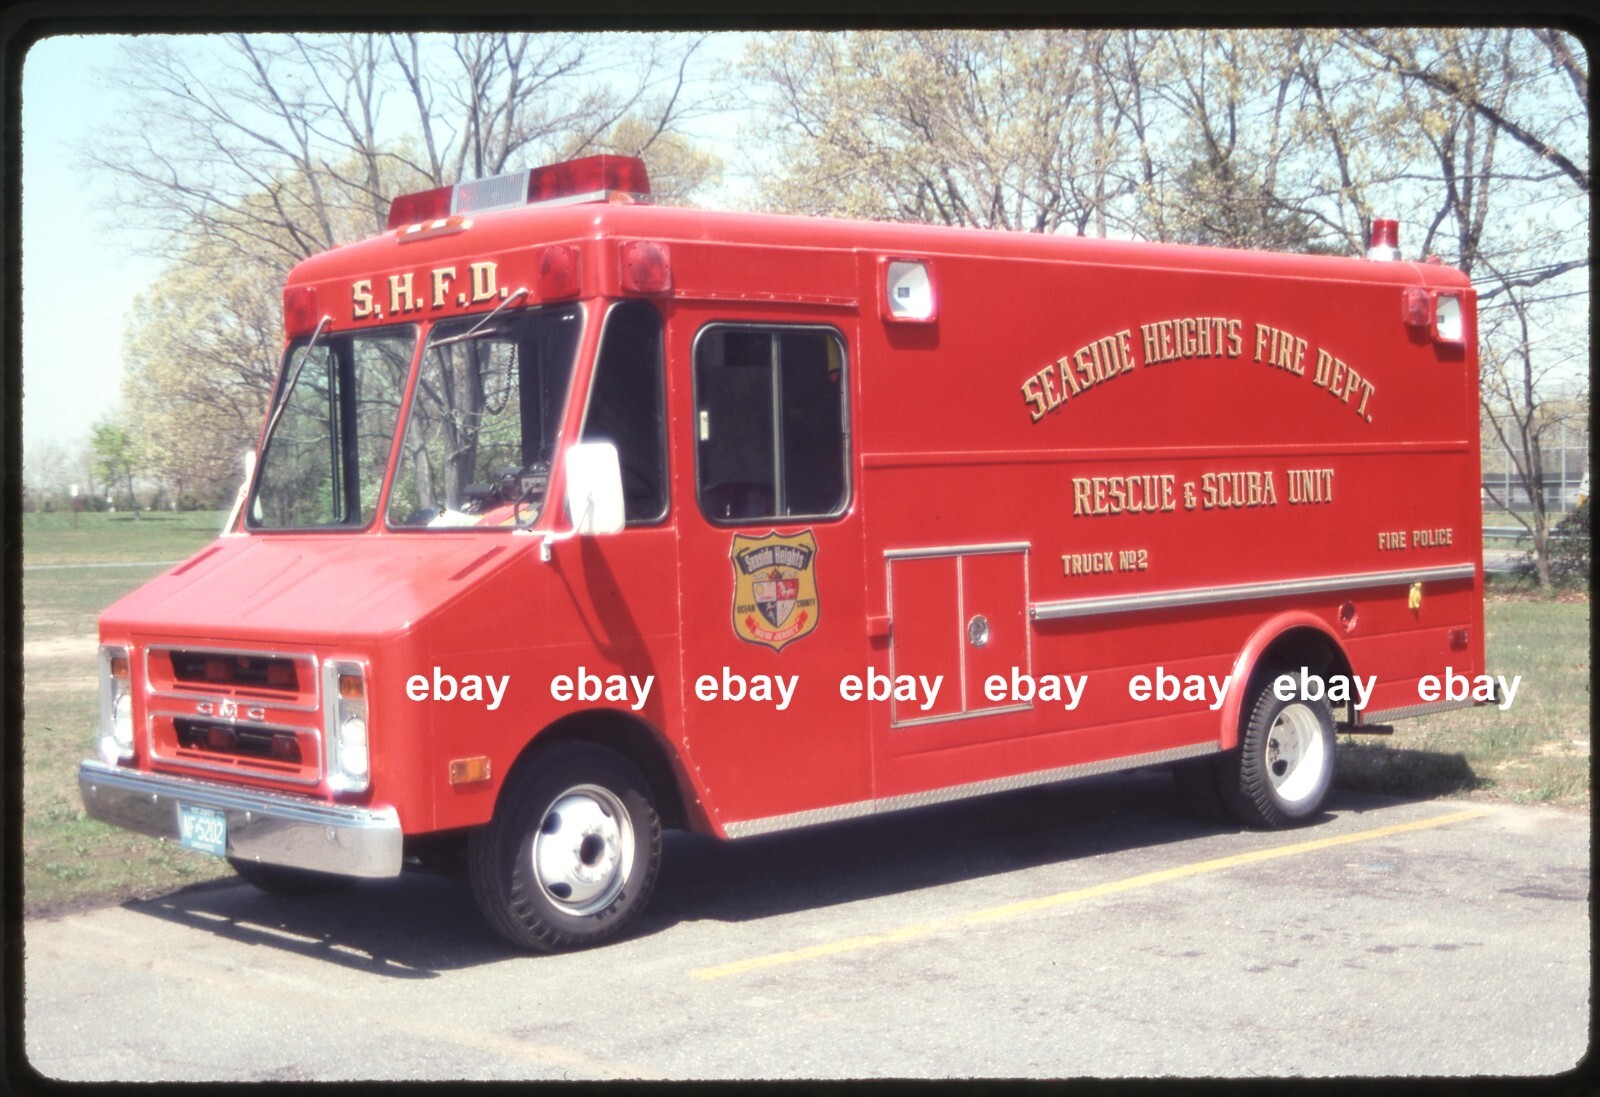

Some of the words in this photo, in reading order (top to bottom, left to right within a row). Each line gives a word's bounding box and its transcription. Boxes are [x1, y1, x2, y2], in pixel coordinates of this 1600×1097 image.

[1021, 329, 1136, 422] SEASIDE
[1141, 317, 1243, 365] HEIGHTS
[1254, 323, 1309, 376] FIRE
[1313, 347, 1376, 424] DEPT.
[1072, 474, 1176, 516] RESCUE
[1184, 482, 1197, 509] &
[1202, 471, 1278, 508] SCUBA
[1287, 468, 1334, 504] UNIT
[1377, 531, 1407, 551] FIRE
[1412, 528, 1453, 548] POLICE
[774, 546, 804, 569] Heights
[1062, 552, 1114, 576] TRUCK
[196, 698, 265, 722] GMC
